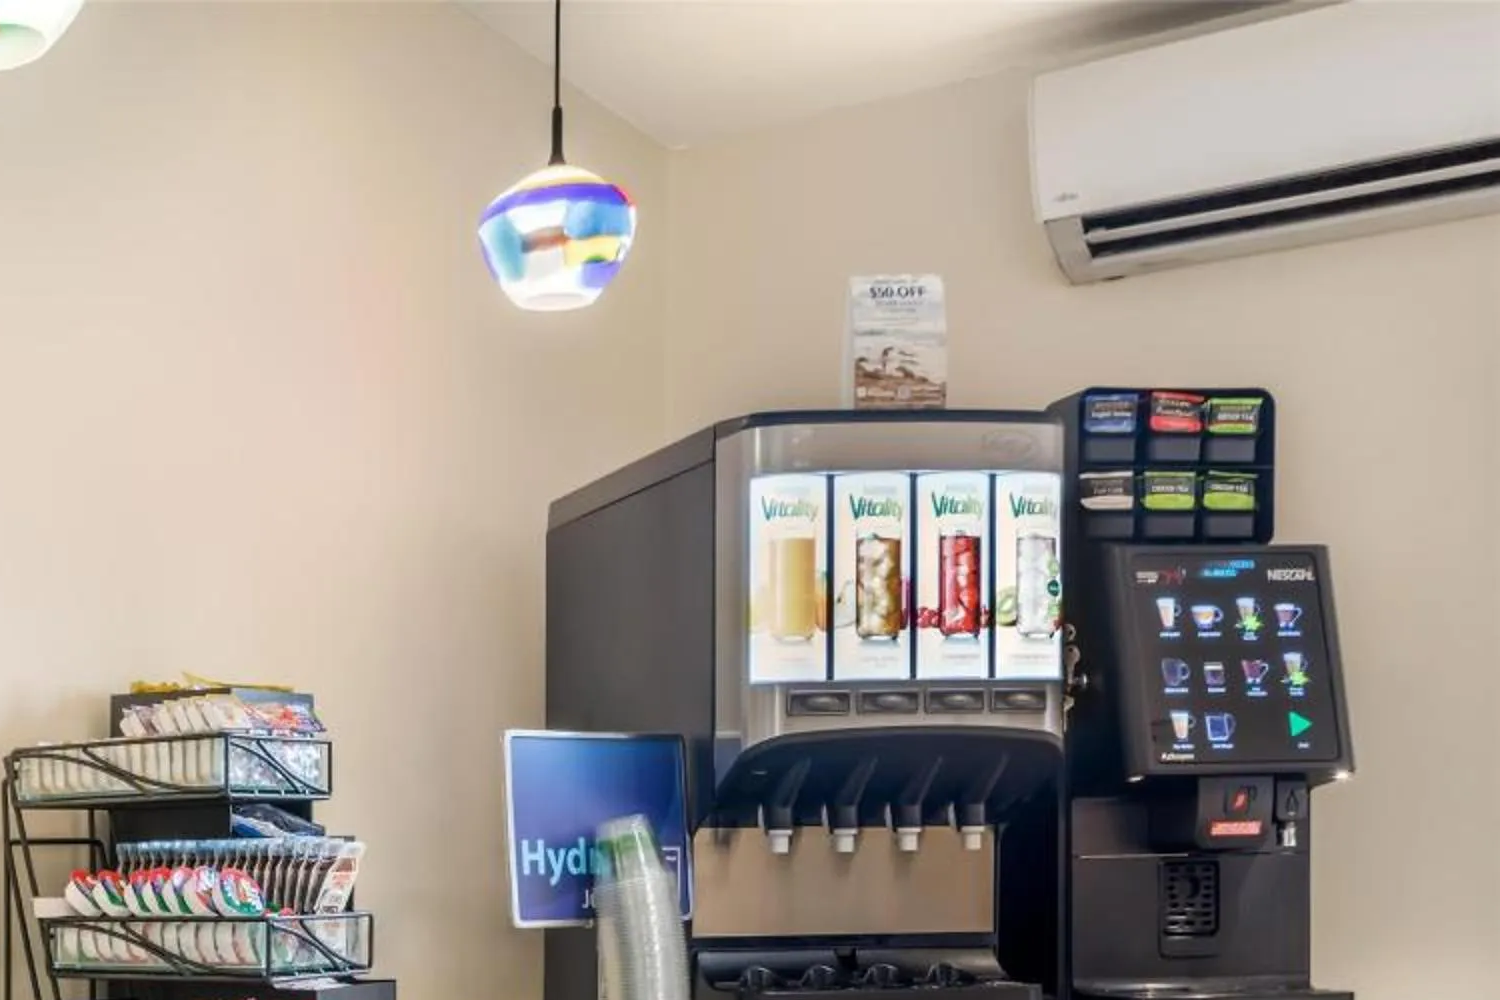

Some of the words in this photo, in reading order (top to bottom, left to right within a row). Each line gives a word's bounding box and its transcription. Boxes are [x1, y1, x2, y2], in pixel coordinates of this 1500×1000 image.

[869, 286, 894, 299] $50
[897, 286, 924, 299] OFF
[761, 495, 819, 522] Vitality
[849, 494, 903, 521] Vitality
[931, 491, 984, 519] Vitality
